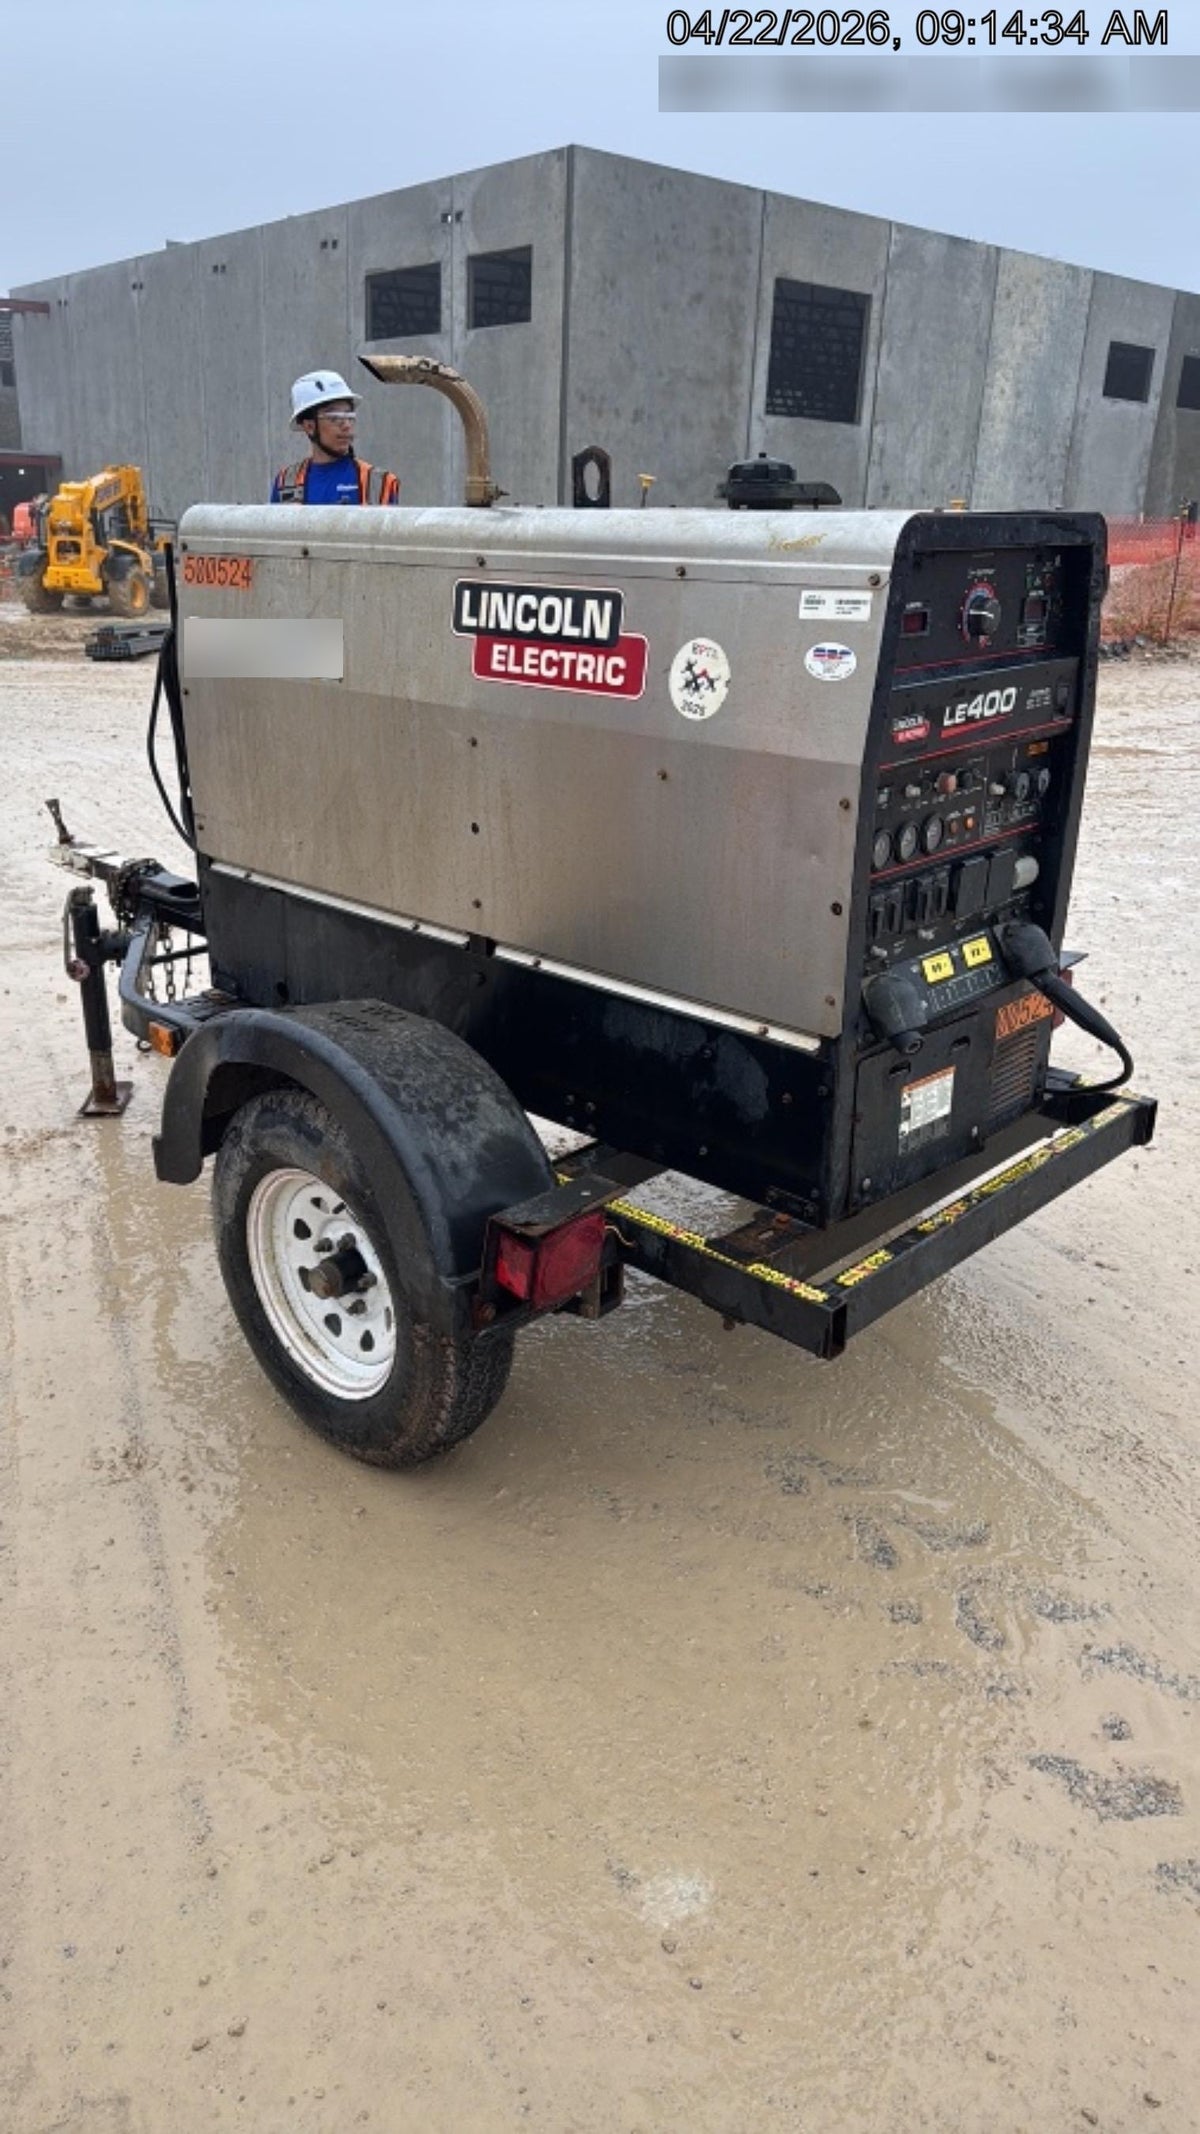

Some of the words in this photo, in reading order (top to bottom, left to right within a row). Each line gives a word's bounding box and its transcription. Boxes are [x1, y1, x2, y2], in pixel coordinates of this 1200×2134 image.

[461, 589, 613, 641] LINCOLN
[490, 643, 627, 686] ELECTRIC
[944, 686, 1017, 727] LE400
